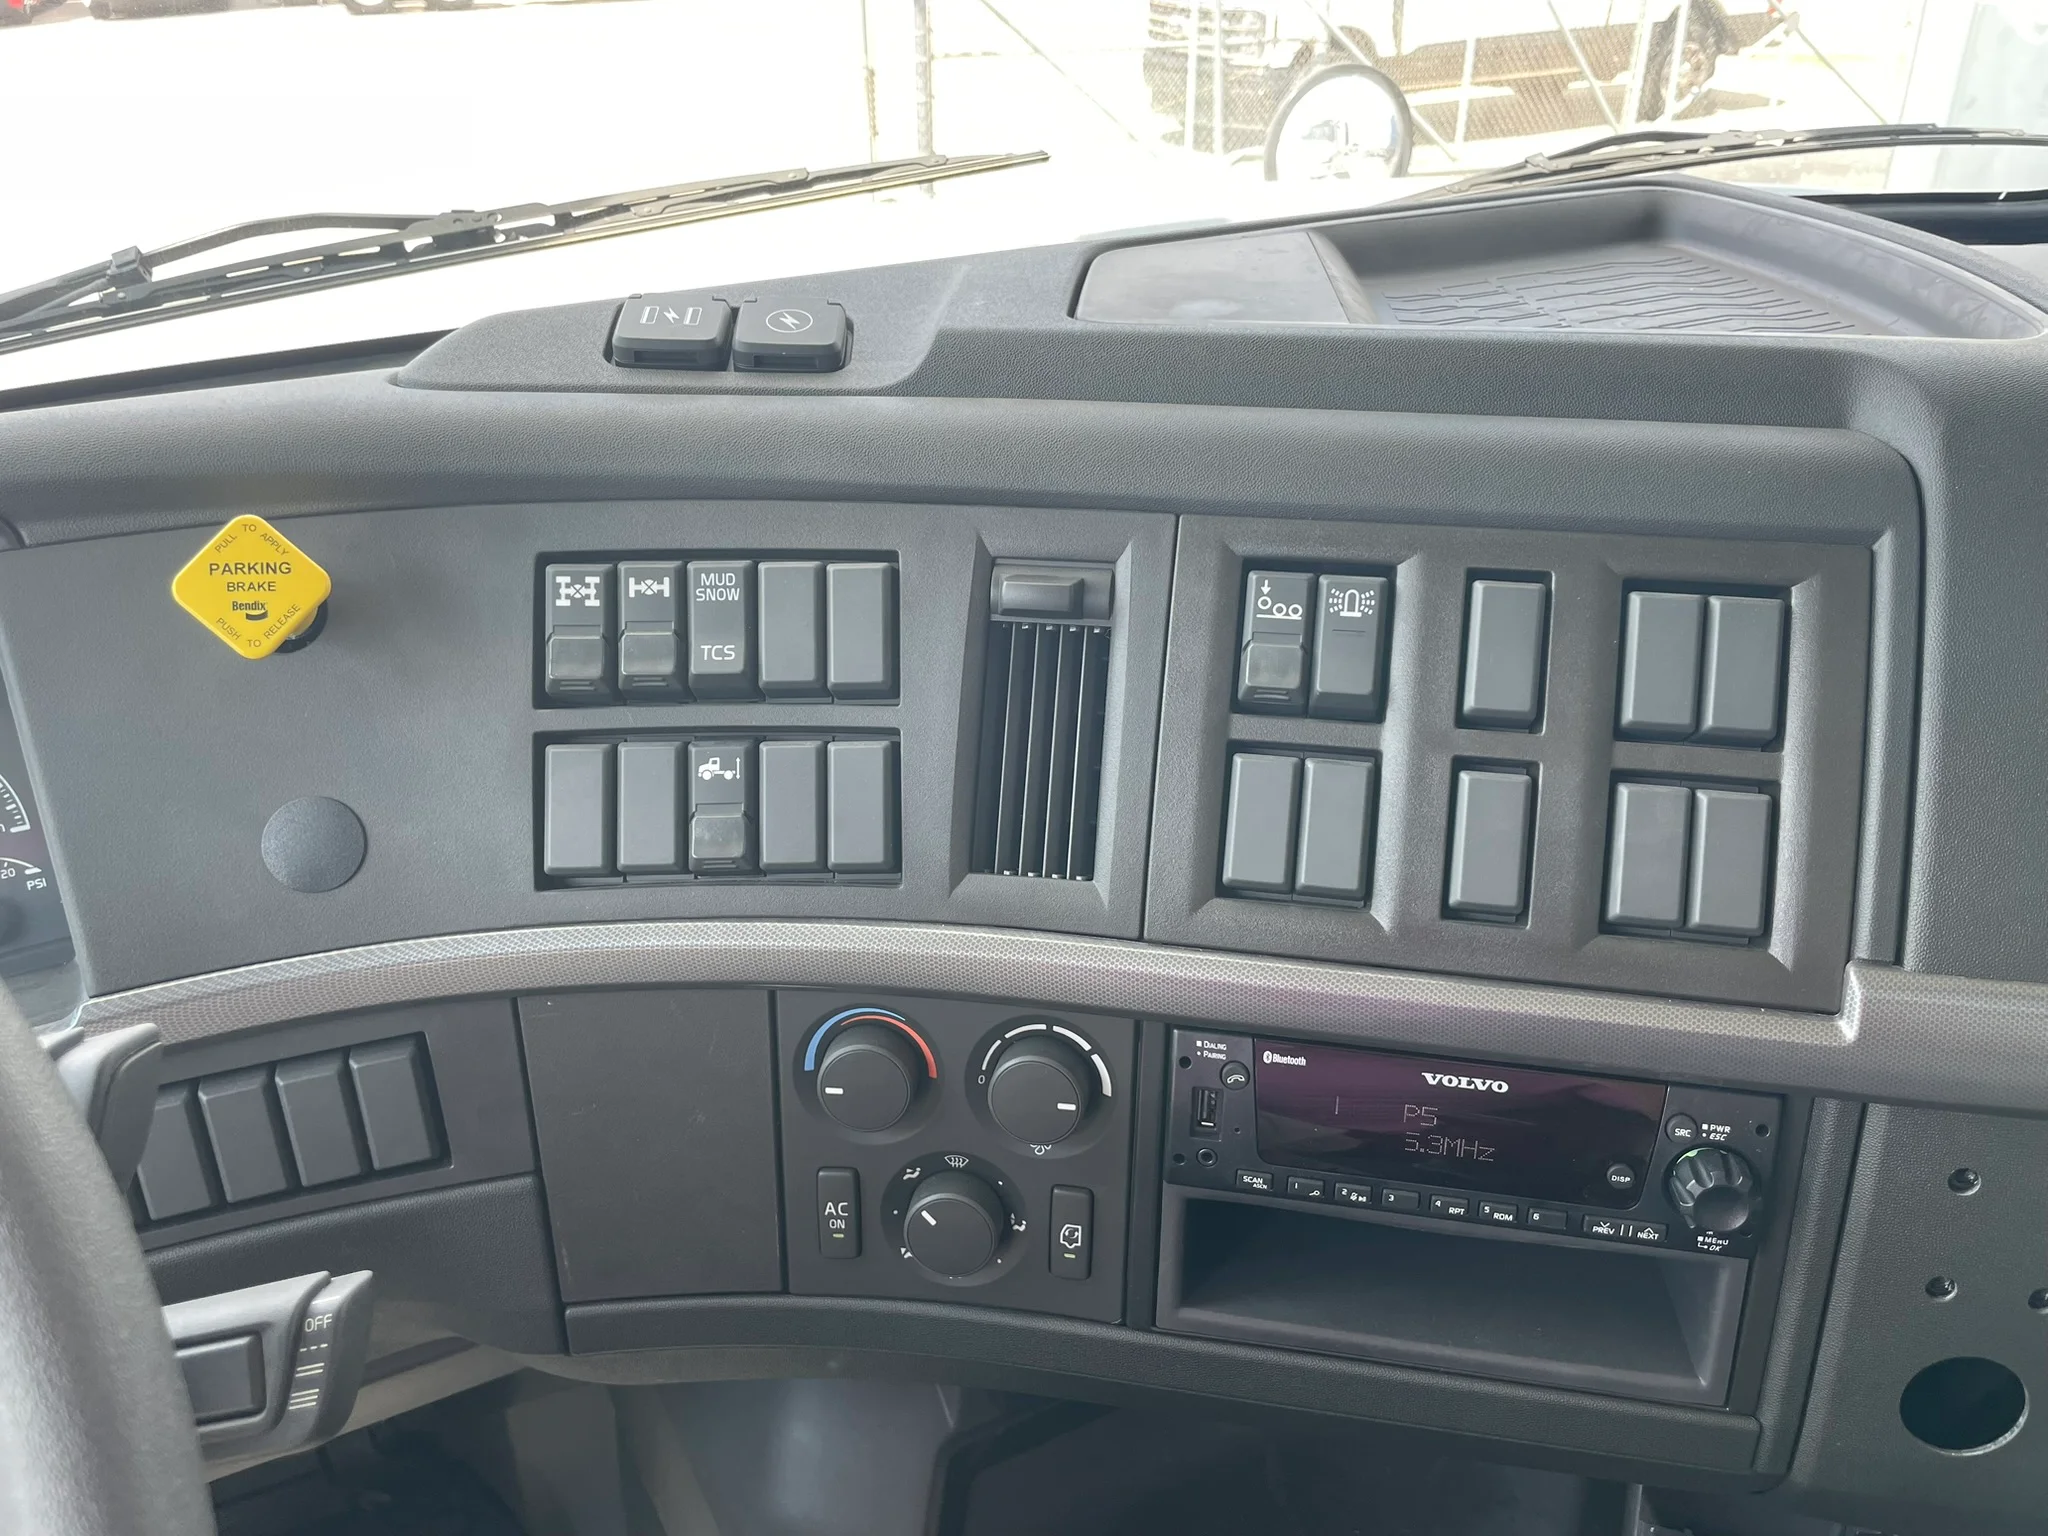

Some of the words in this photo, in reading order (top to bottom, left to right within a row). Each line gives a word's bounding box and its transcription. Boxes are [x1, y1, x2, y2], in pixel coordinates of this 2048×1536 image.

[214, 534, 238, 554] PULL
[242, 524, 257, 533] TO
[260, 532, 290, 556] APPLY
[209, 561, 292, 576] PARKING
[700, 572, 736, 587] MUD
[226, 581, 277, 592] BRAKE
[696, 588, 740, 602] SNOW
[231, 600, 267, 612] Bendix
[216, 617, 241, 641] PUSH
[248, 639, 262, 648] TO
[263, 603, 301, 640] RELEASE
[700, 645, 736, 661] TCS
[26, 877, 48, 891] PSI
[1272, 1053, 1307, 1067] Bluetooth
[1421, 1072, 1509, 1094] VOLVO
[1674, 1128, 1692, 1138] SRC
[1709, 1123, 1731, 1134] PWR
[1708, 1132, 1728, 1141] ESC
[1242, 1175, 1264, 1185] SCAN
[1611, 1174, 1631, 1184] DISP
[1341, 1188, 1348, 1196] 2
[1387, 1194, 1395, 1202] 3
[825, 1202, 849, 1217] AC
[1434, 1200, 1442, 1208] 4
[1448, 1206, 1466, 1217] RPT
[1483, 1205, 1490, 1214] 5
[1492, 1212, 1514, 1222] RDM
[1532, 1213, 1540, 1221] 6
[829, 1219, 845, 1230] ON
[1592, 1225, 1615, 1236] PREV
[1637, 1231, 1660, 1241] NEXT
[1709, 1244, 1722, 1252] OK
[305, 1313, 333, 1333] OFF
